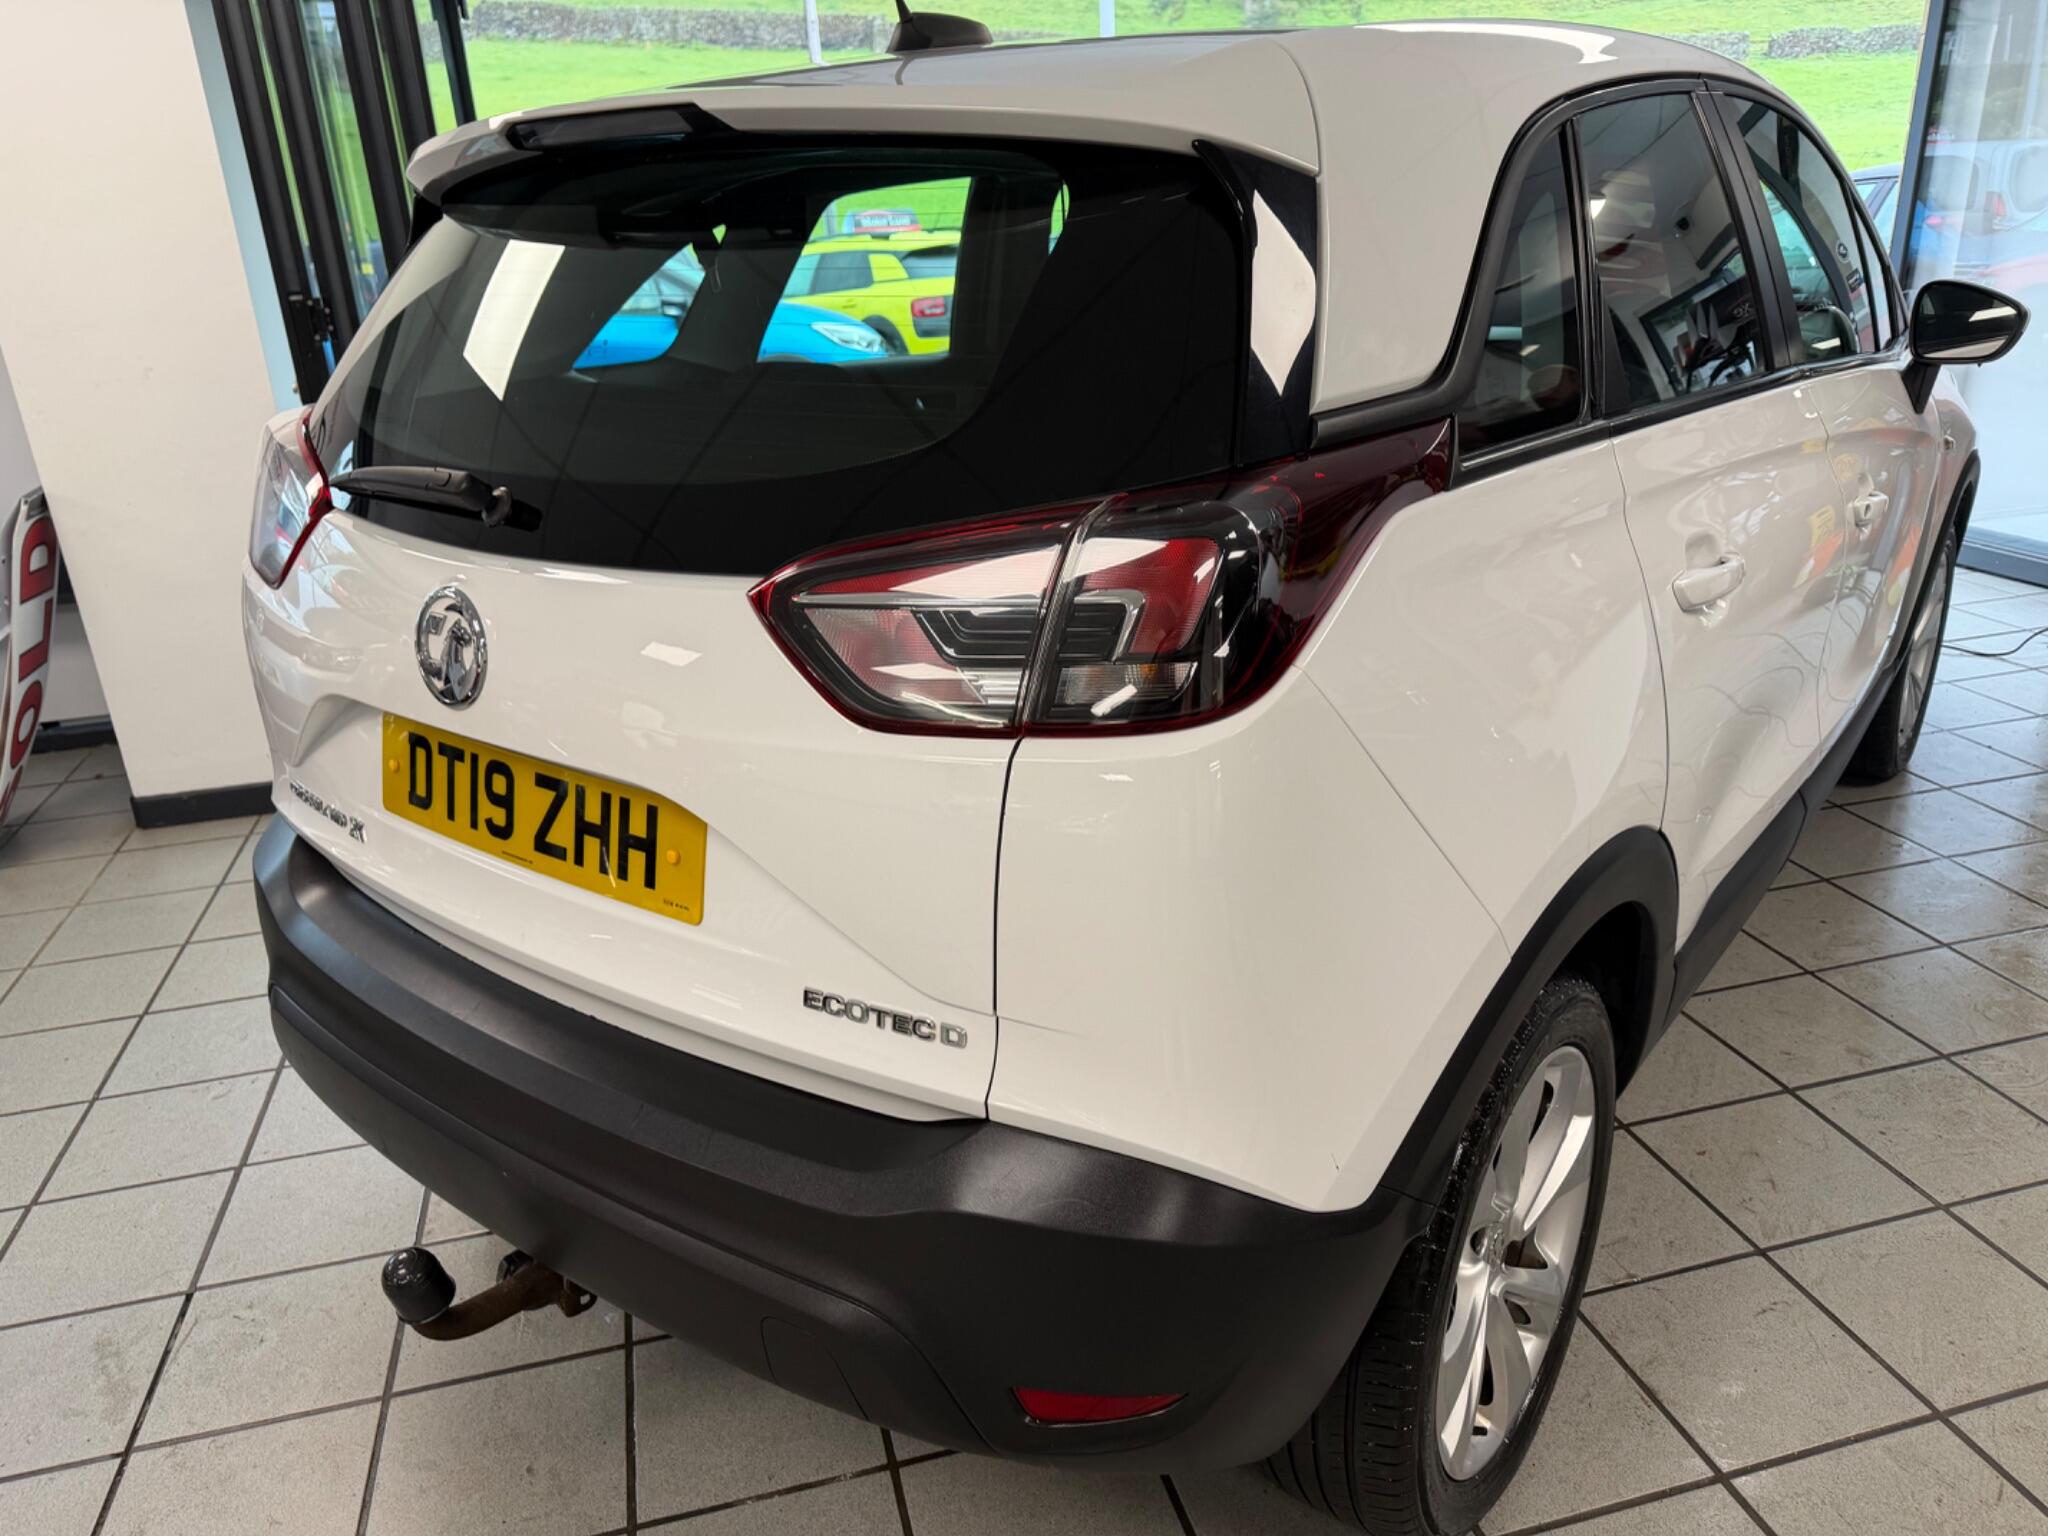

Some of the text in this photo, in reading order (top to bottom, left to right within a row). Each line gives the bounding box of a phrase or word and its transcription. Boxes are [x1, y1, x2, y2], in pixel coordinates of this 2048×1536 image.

[408, 731, 658, 889] DT19 ZHH
[803, 986, 968, 1050] ECOTEC D
